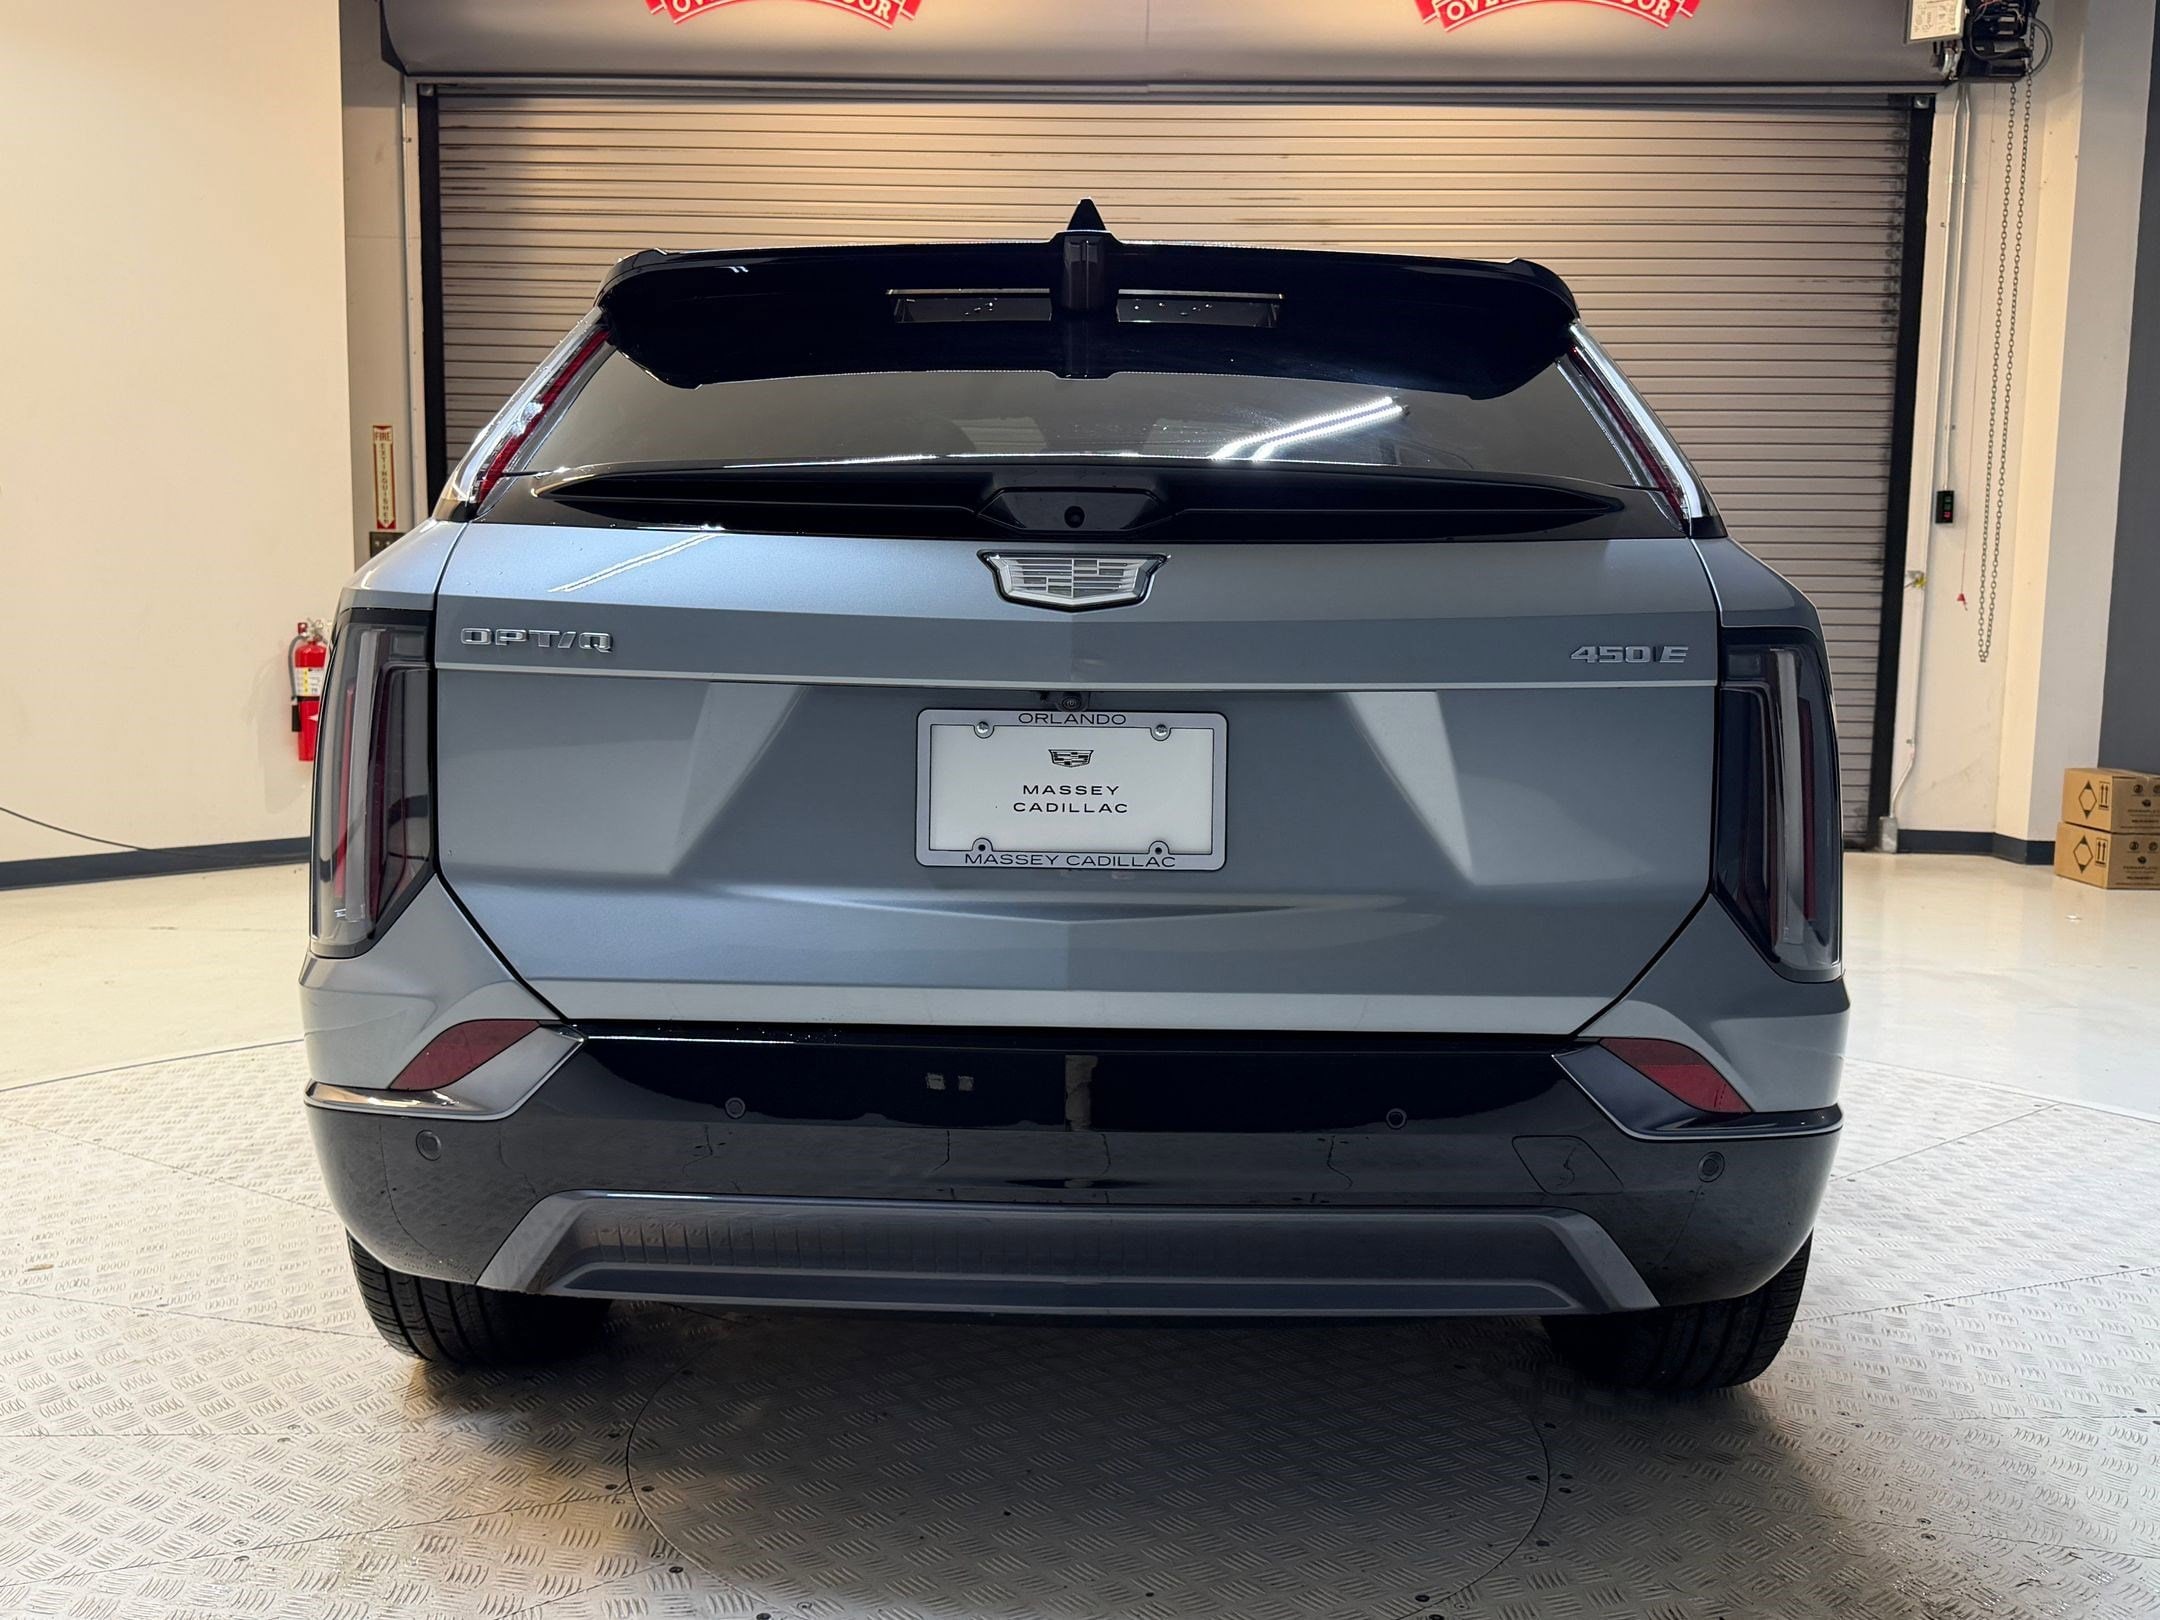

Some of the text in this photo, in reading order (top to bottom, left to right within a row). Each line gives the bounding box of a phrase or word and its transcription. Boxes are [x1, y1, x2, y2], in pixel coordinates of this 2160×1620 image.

[375, 432, 390, 441] FIRE
[1570, 645, 1651, 663] 450
[1018, 712, 1127, 725] ORLANDO
[1022, 784, 1120, 796] MASSEY
[1013, 802, 1128, 814] CADILLAC
[964, 853, 1176, 868] MASSEY CADILLAC
